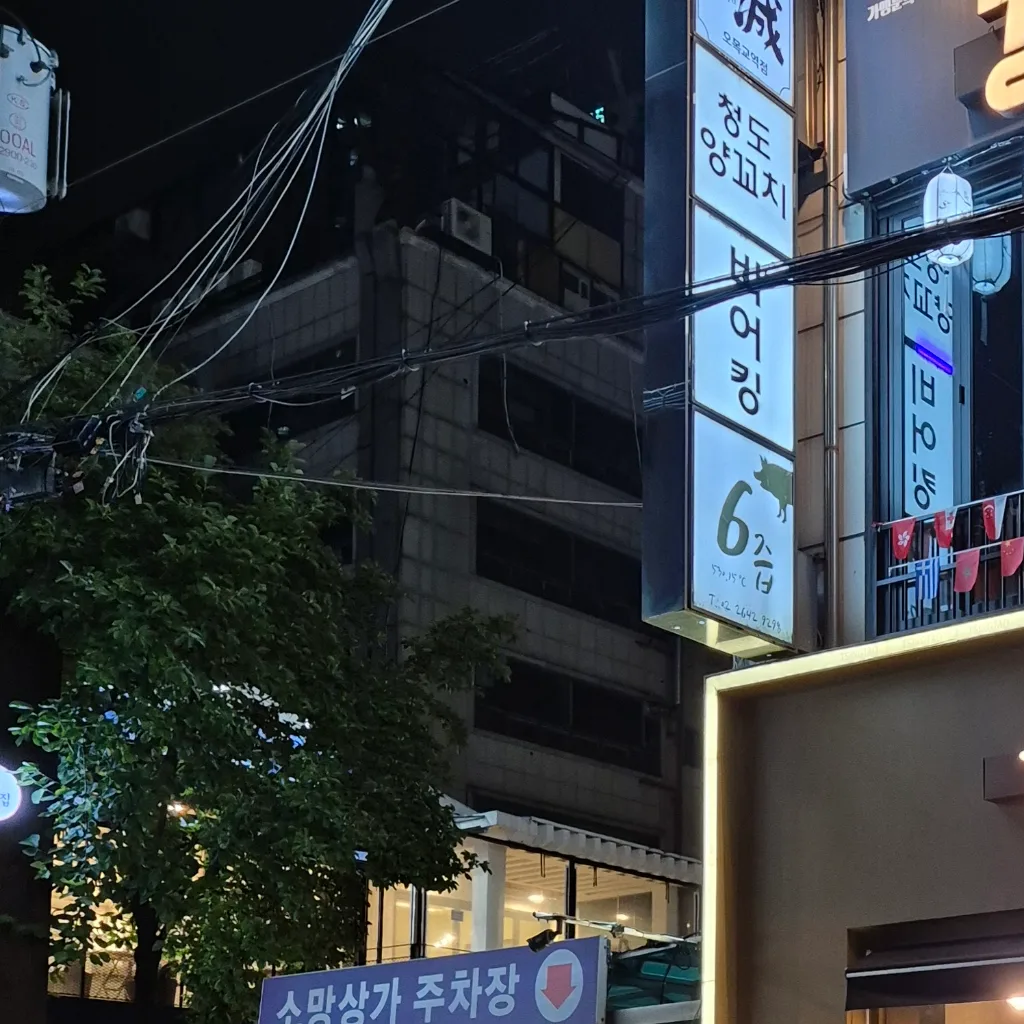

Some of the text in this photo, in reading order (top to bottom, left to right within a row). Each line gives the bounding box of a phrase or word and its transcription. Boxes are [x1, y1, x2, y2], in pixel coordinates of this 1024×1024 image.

[722, 31, 768, 77] 오목교역점
[717, 92, 771, 160] 청도
[701, 127, 786, 220] 양꼬치
[413, 963, 520, 1023] 주차장
